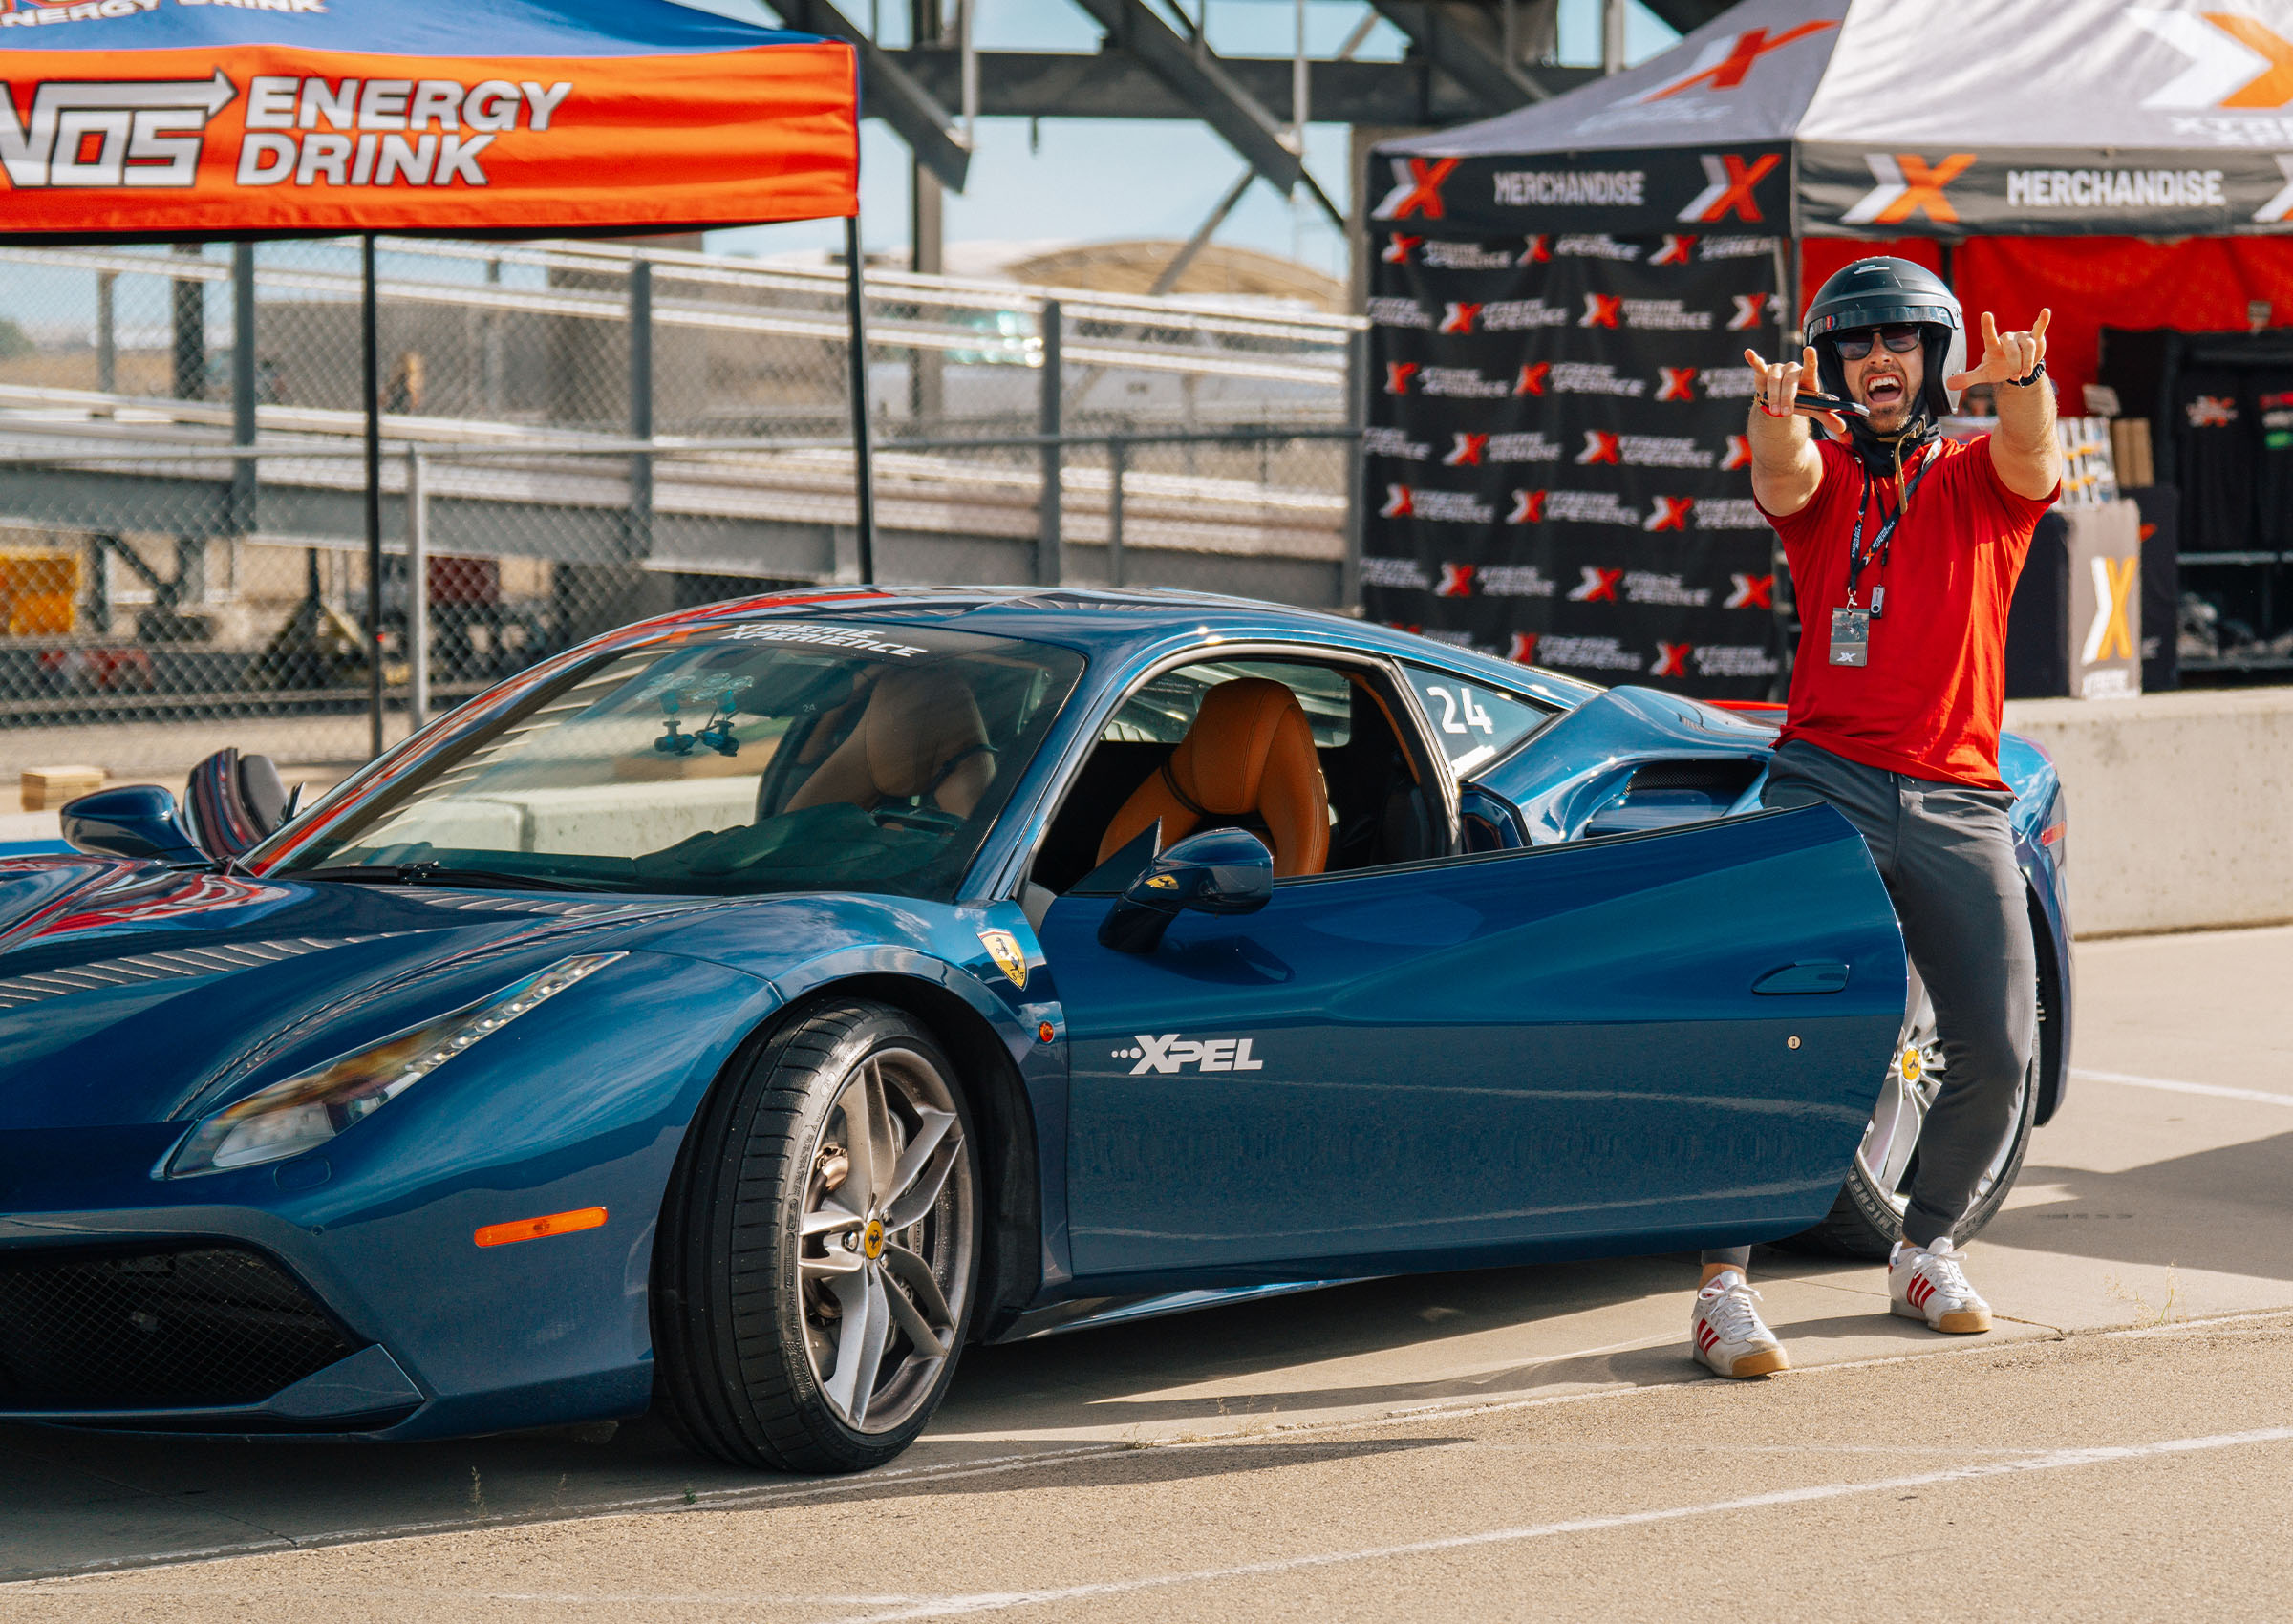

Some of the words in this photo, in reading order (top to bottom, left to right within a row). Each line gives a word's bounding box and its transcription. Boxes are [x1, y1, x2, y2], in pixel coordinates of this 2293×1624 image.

[0, 0, 160, 28] NERGY
[245, 75, 573, 132] ENERGY
[0, 76, 239, 188] NOS
[235, 133, 497, 186] DRINK
[1492, 170, 1646, 206] MERCHANDISE
[2006, 169, 2226, 206] MERCHANDISE
[718, 631, 928, 657] XPERIENCE
[721, 623, 886, 639] XTREME
[1426, 686, 1493, 735] 24
[1128, 1034, 1263, 1075] XPEL
[1848, 1165, 1892, 1229] MICHEL
